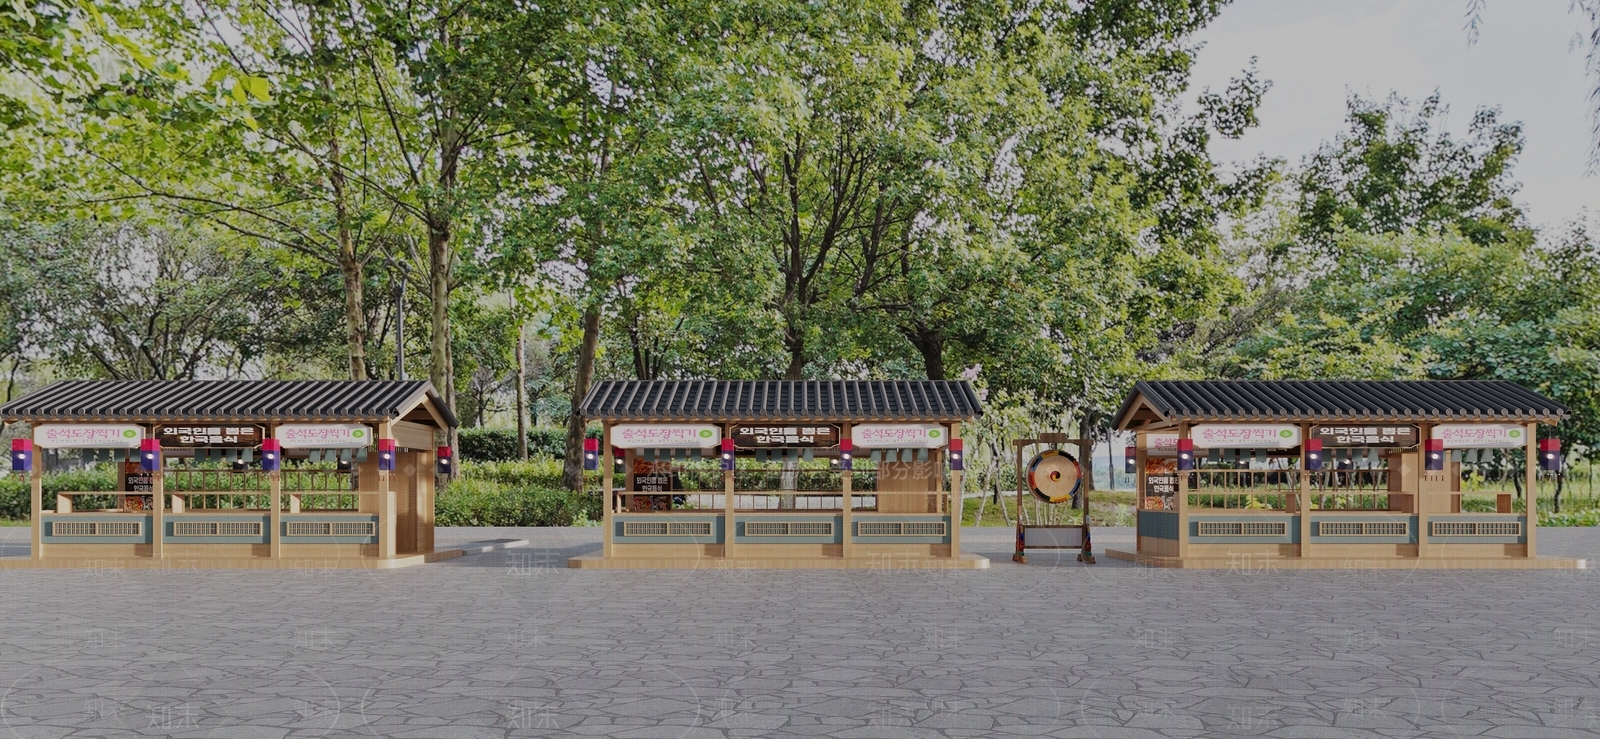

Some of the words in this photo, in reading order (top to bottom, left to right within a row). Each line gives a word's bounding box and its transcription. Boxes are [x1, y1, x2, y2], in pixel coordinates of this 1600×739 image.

[46, 428, 120, 439] 출석도장찍기
[285, 428, 350, 439] 출석도장찍기
[622, 428, 696, 439] 출석도장찍기
[861, 428, 926, 439] 출석도장찍기
[1202, 428, 1276, 439] 출석도장찍기
[1441, 428, 1507, 439] 출석도장찍기
[180, 435, 237, 444] 한국음식
[756, 435, 814, 444] 한국음식
[1336, 435, 1394, 444] 한국음식
